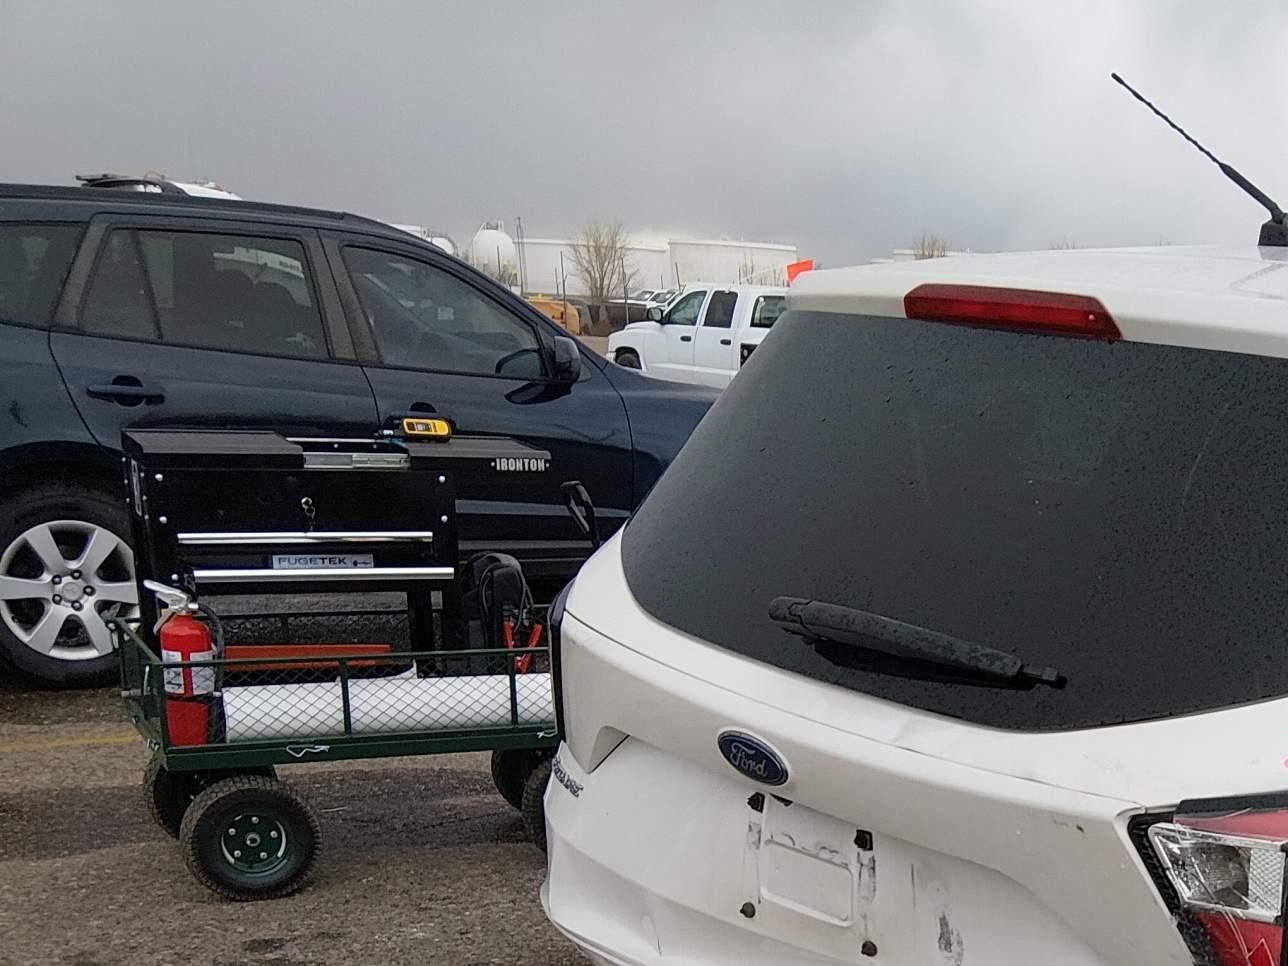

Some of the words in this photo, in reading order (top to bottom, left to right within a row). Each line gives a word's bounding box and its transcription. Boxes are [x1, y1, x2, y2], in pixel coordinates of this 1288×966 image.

[495, 457, 545, 471] IRONTON
[278, 556, 347, 566] FUGETEK
[729, 742, 769, 777] Ford
